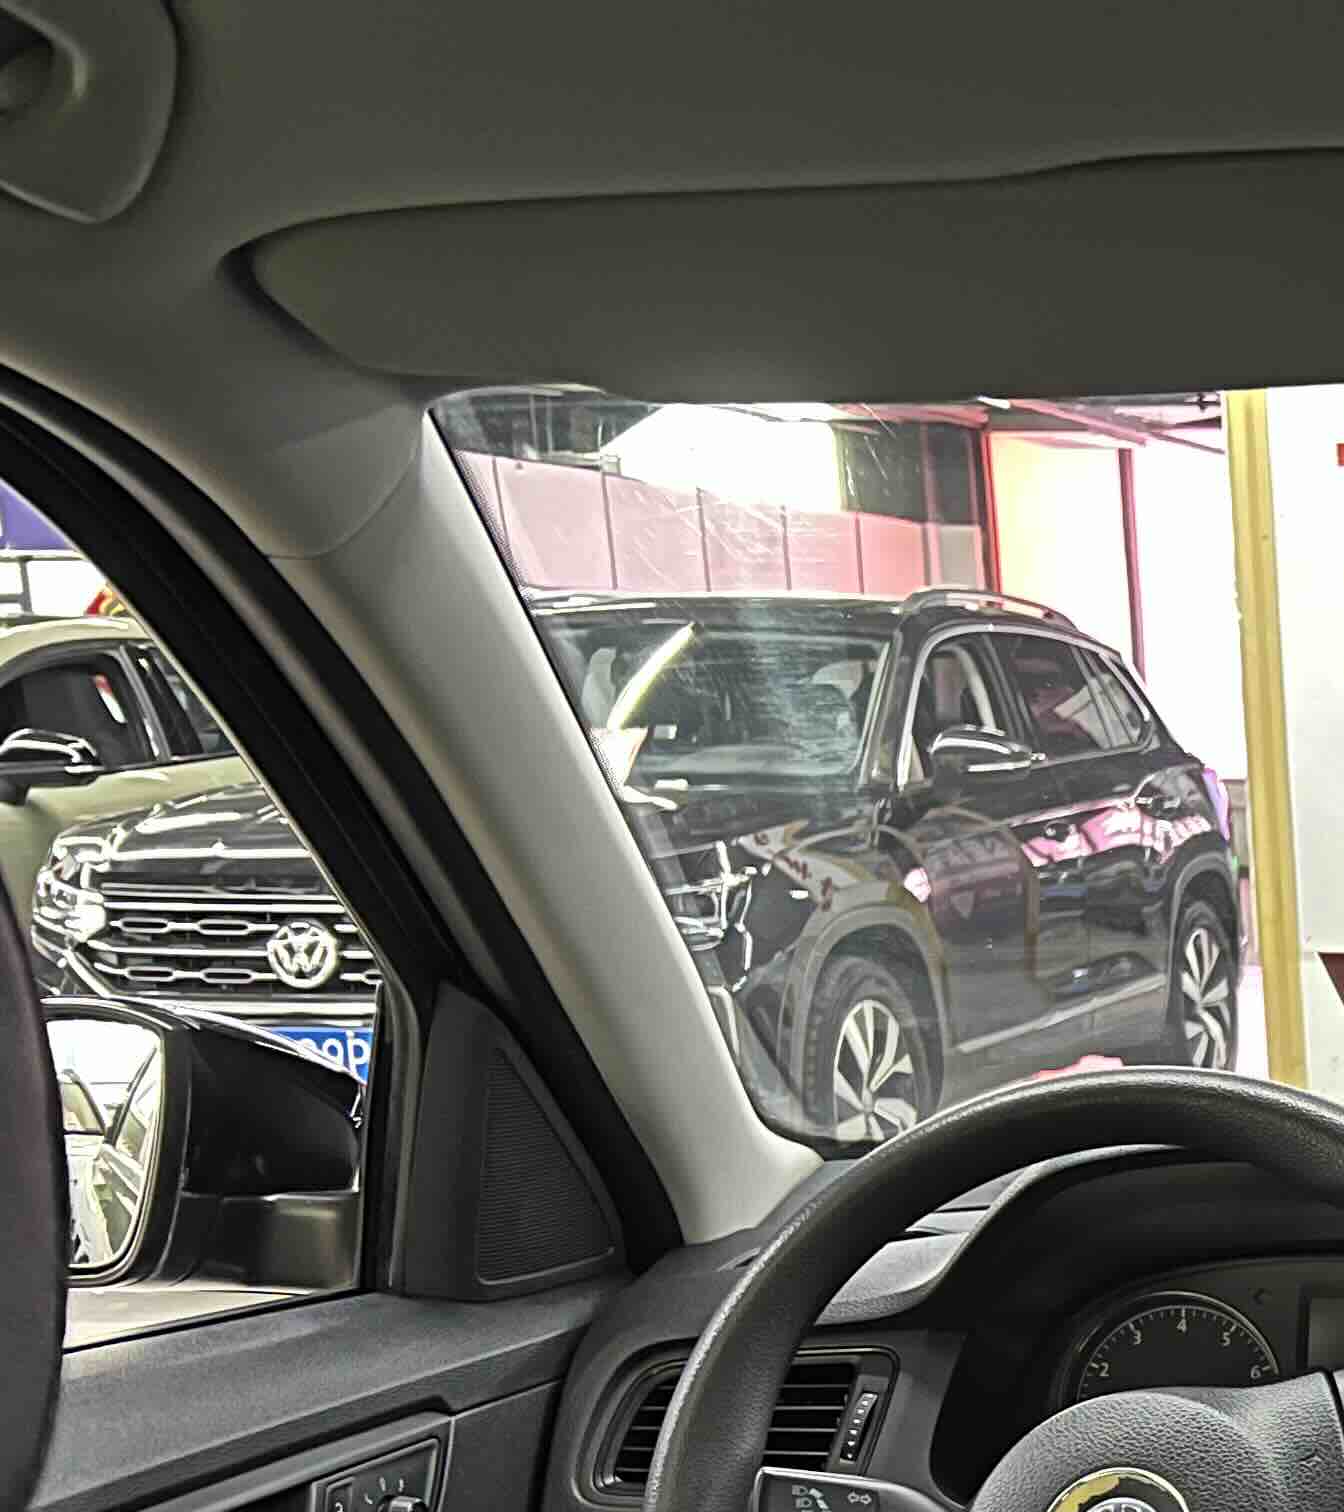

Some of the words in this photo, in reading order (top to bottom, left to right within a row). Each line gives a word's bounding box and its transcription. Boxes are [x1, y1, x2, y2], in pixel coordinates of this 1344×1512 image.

[1176, 1318, 1188, 1333] 4
[1133, 1330, 1143, 1346] 3
[1221, 1332, 1232, 1347] 5
[1099, 1362, 1110, 1377] 2
[1250, 1365, 1262, 1380] 6
